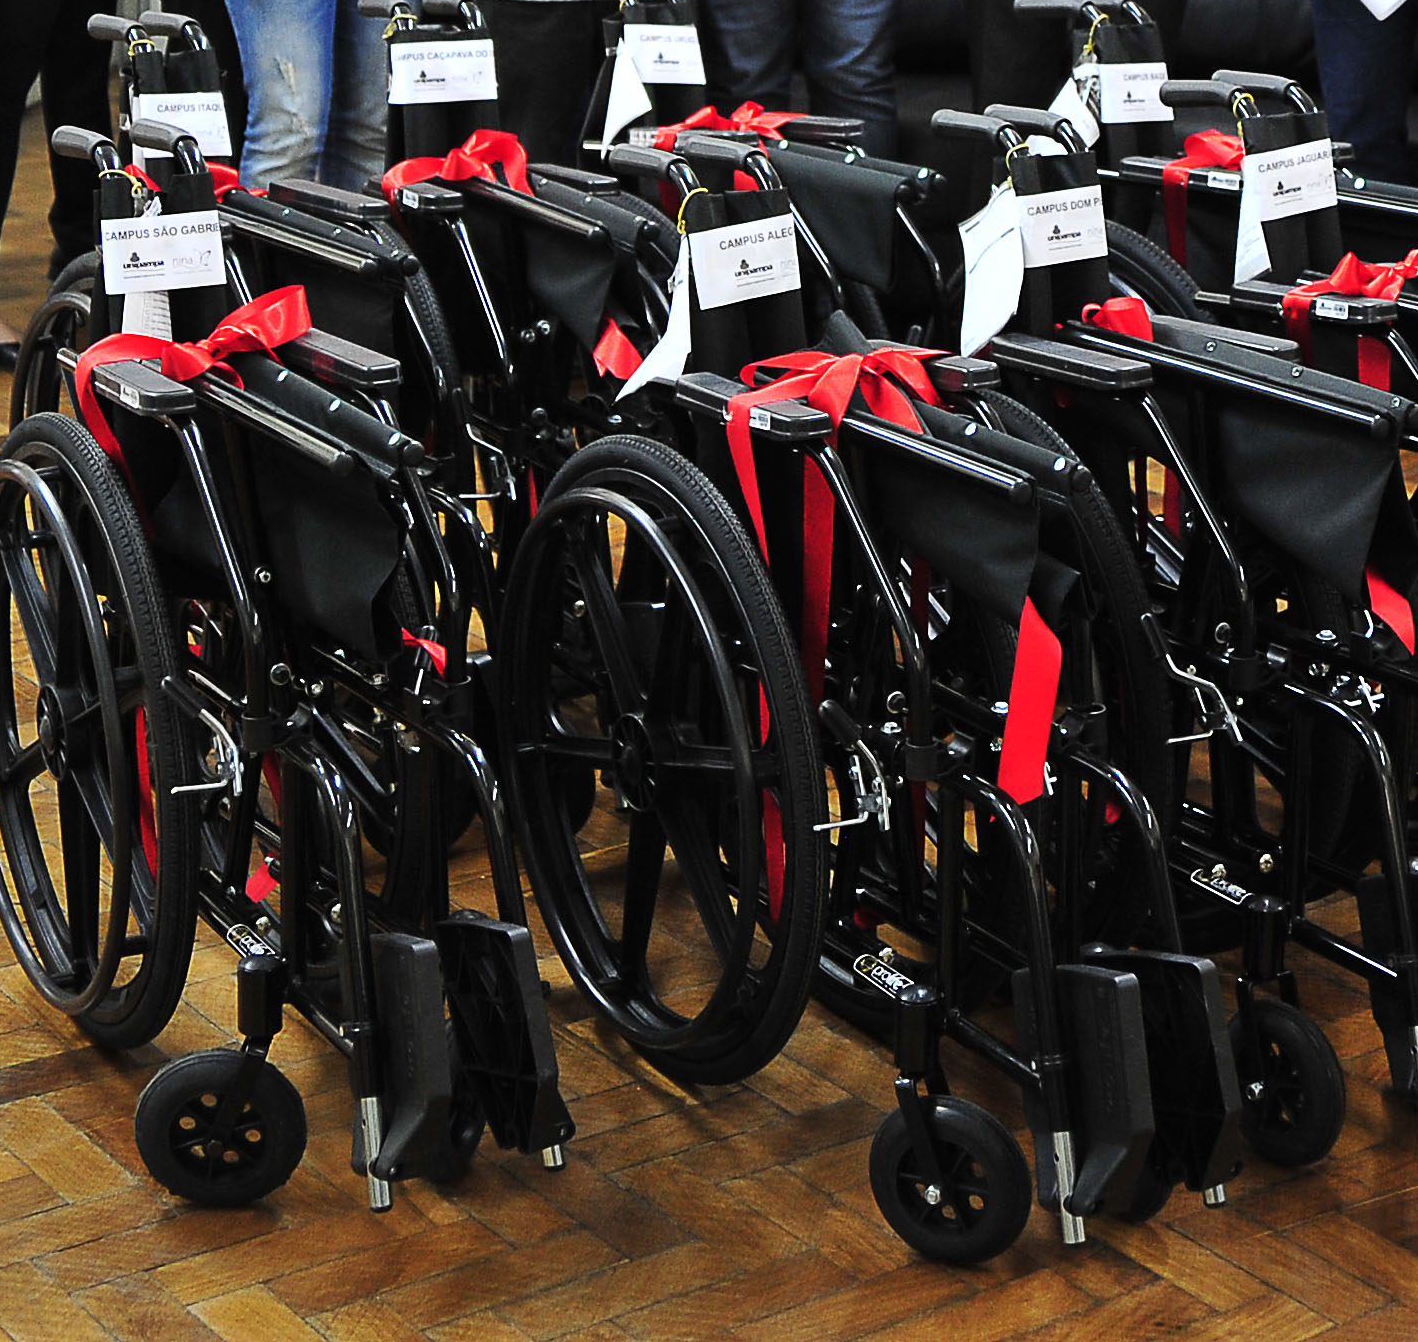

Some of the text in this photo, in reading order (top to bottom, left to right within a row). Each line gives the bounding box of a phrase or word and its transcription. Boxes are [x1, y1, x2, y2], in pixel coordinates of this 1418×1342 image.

[475, 49, 488, 58] DO
[157, 103, 196, 113] CAMPUS
[1258, 158, 1295, 174] CAMPUS
[1027, 201, 1069, 217] CAMPUS
[1070, 198, 1092, 210] DOM
[104, 228, 150, 242] CAMPUS
[153, 225, 178, 238] SÃO
[719, 233, 765, 251] CAMPUS
